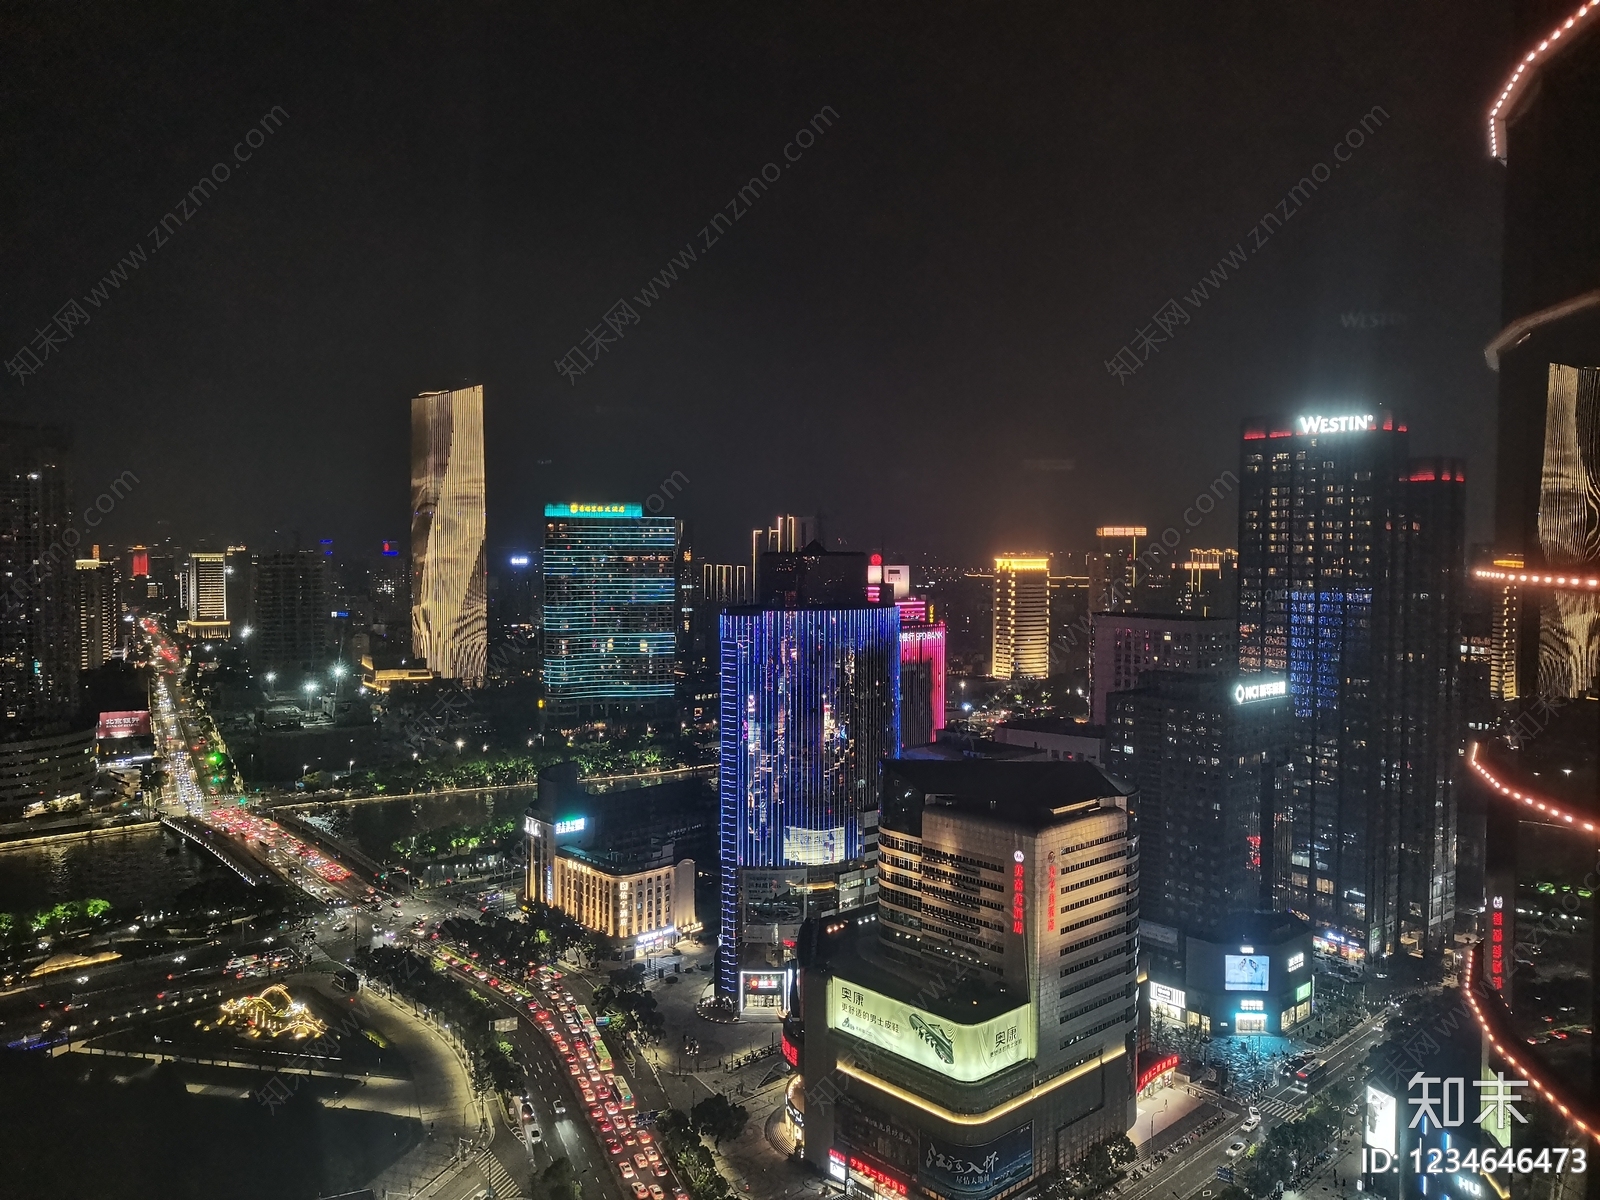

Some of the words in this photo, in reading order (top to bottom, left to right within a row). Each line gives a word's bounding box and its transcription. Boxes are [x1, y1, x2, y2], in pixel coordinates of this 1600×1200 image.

[106, 717, 140, 725] 北京银行
[841, 987, 864, 1007] 奥康
[841, 1002, 900, 1034] 更舒适的男士皮鞋
[995, 1025, 1017, 1048] 奥康
